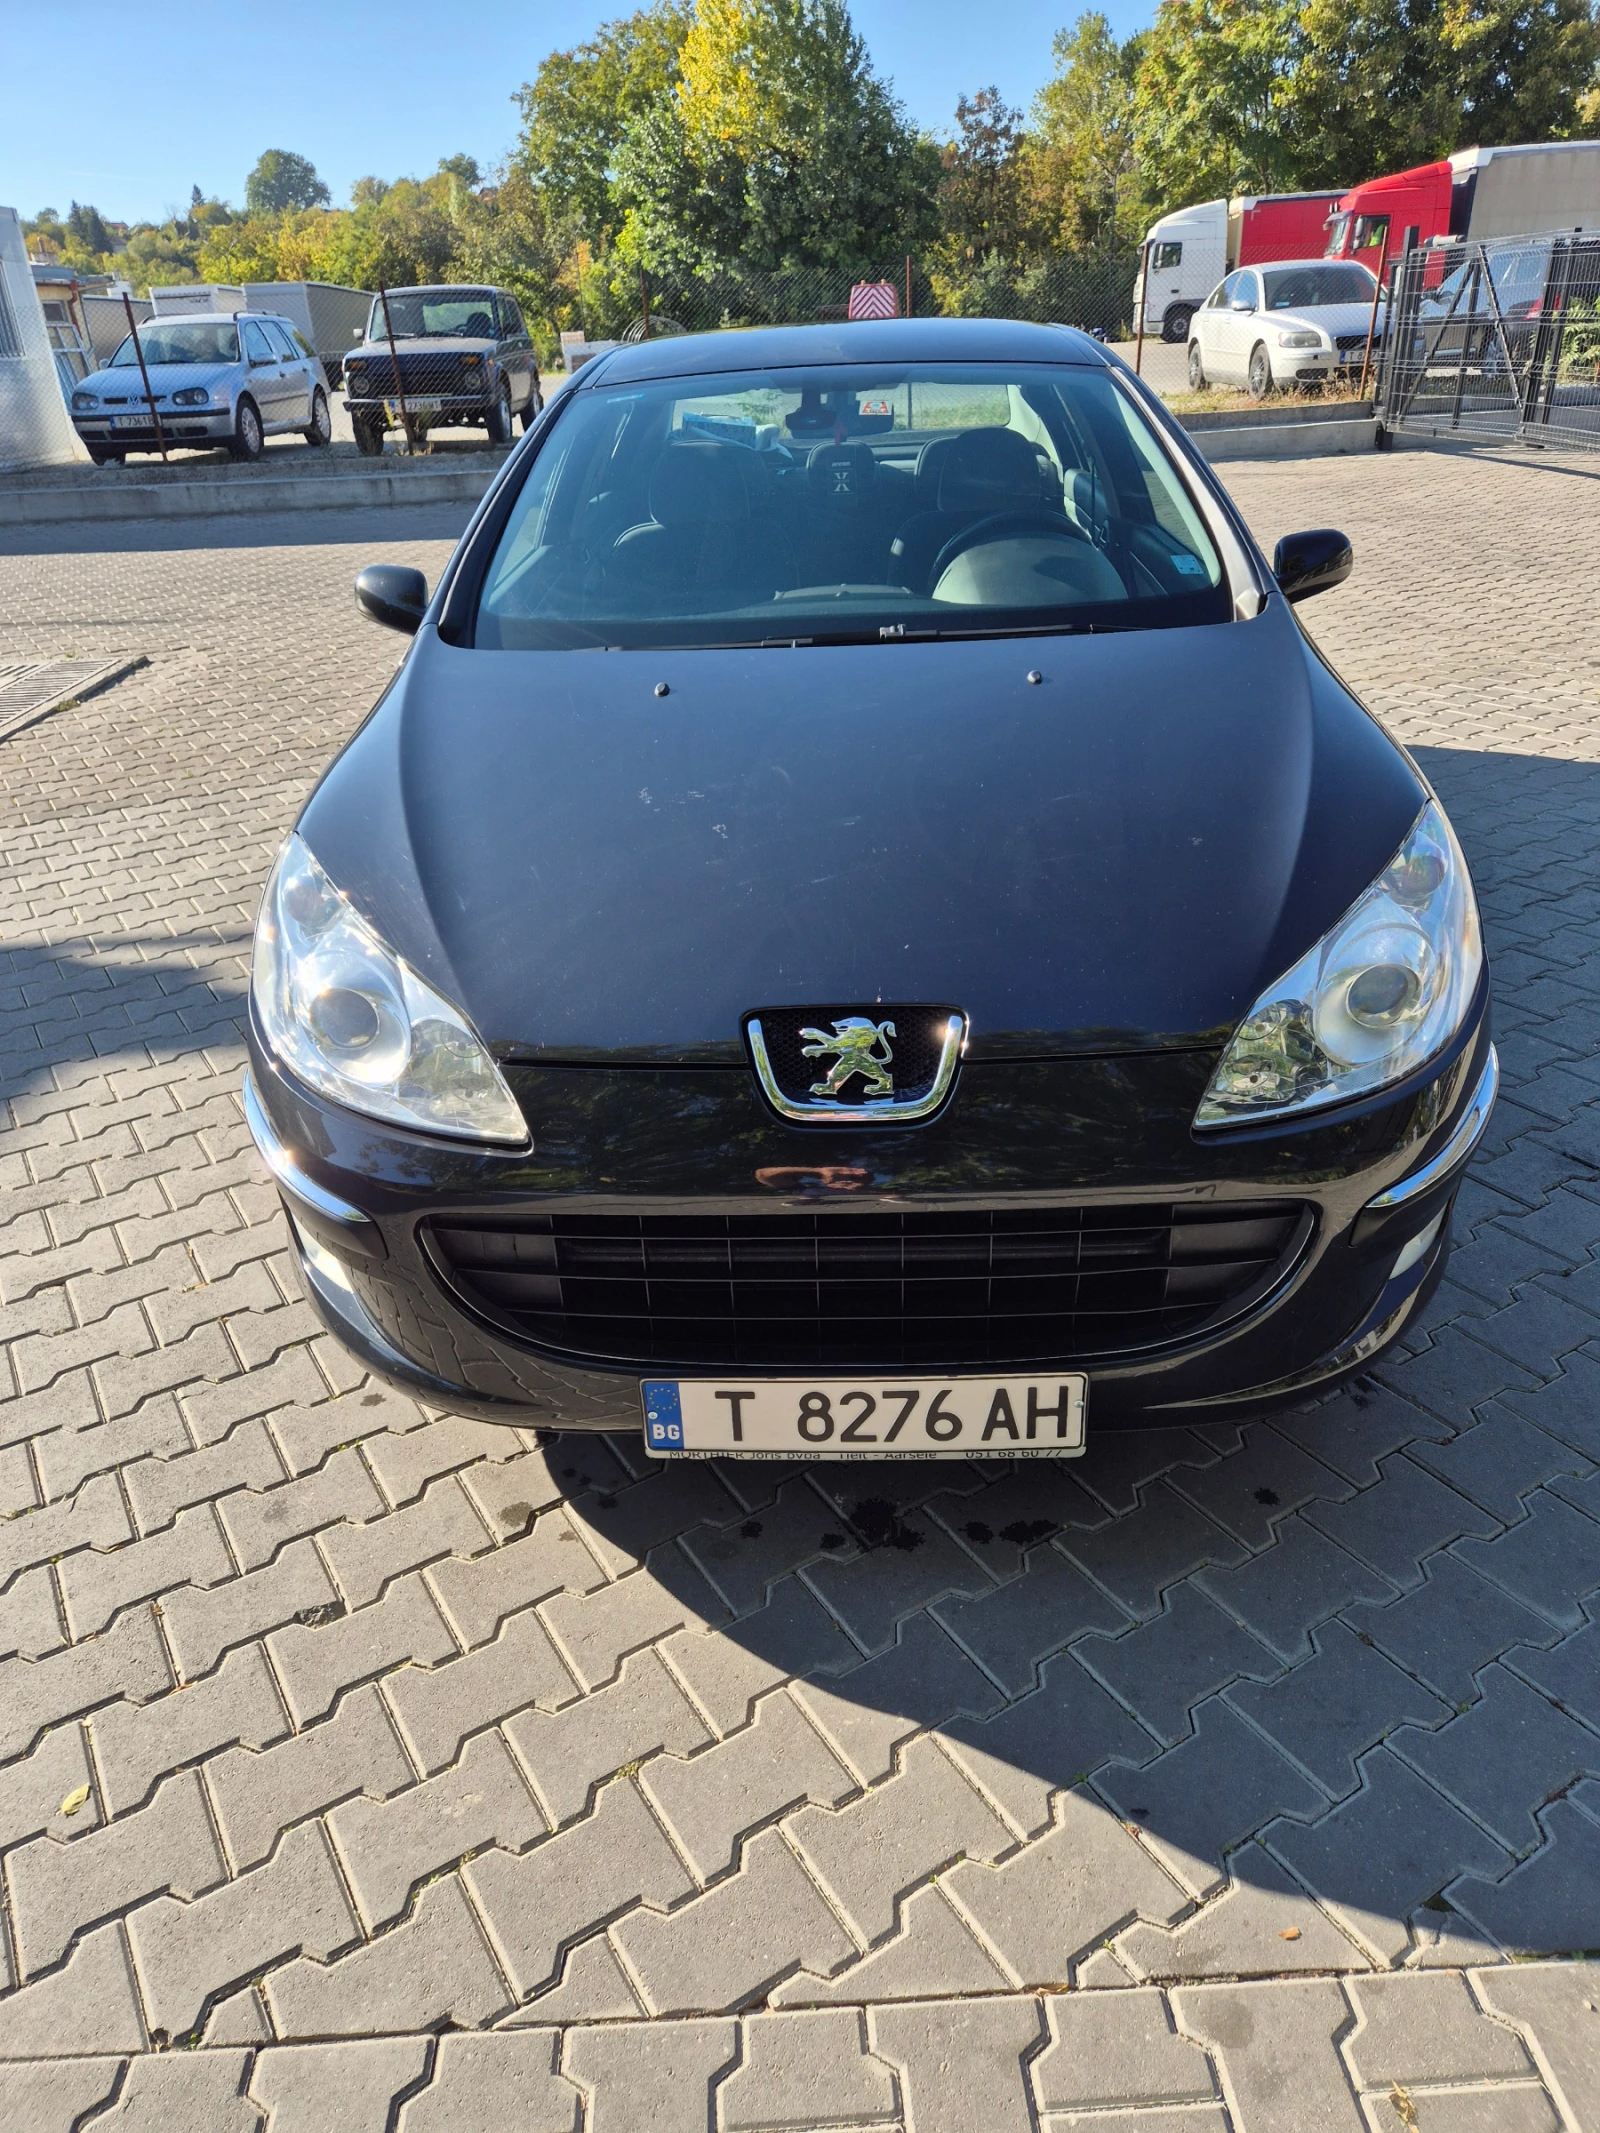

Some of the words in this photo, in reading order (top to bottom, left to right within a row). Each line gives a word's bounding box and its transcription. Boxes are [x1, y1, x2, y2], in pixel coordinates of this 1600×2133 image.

[652, 1423, 681, 1440] BG
[714, 1391, 755, 1441] T
[797, 1389, 962, 1442] 8276
[981, 1385, 1069, 1441] AH
